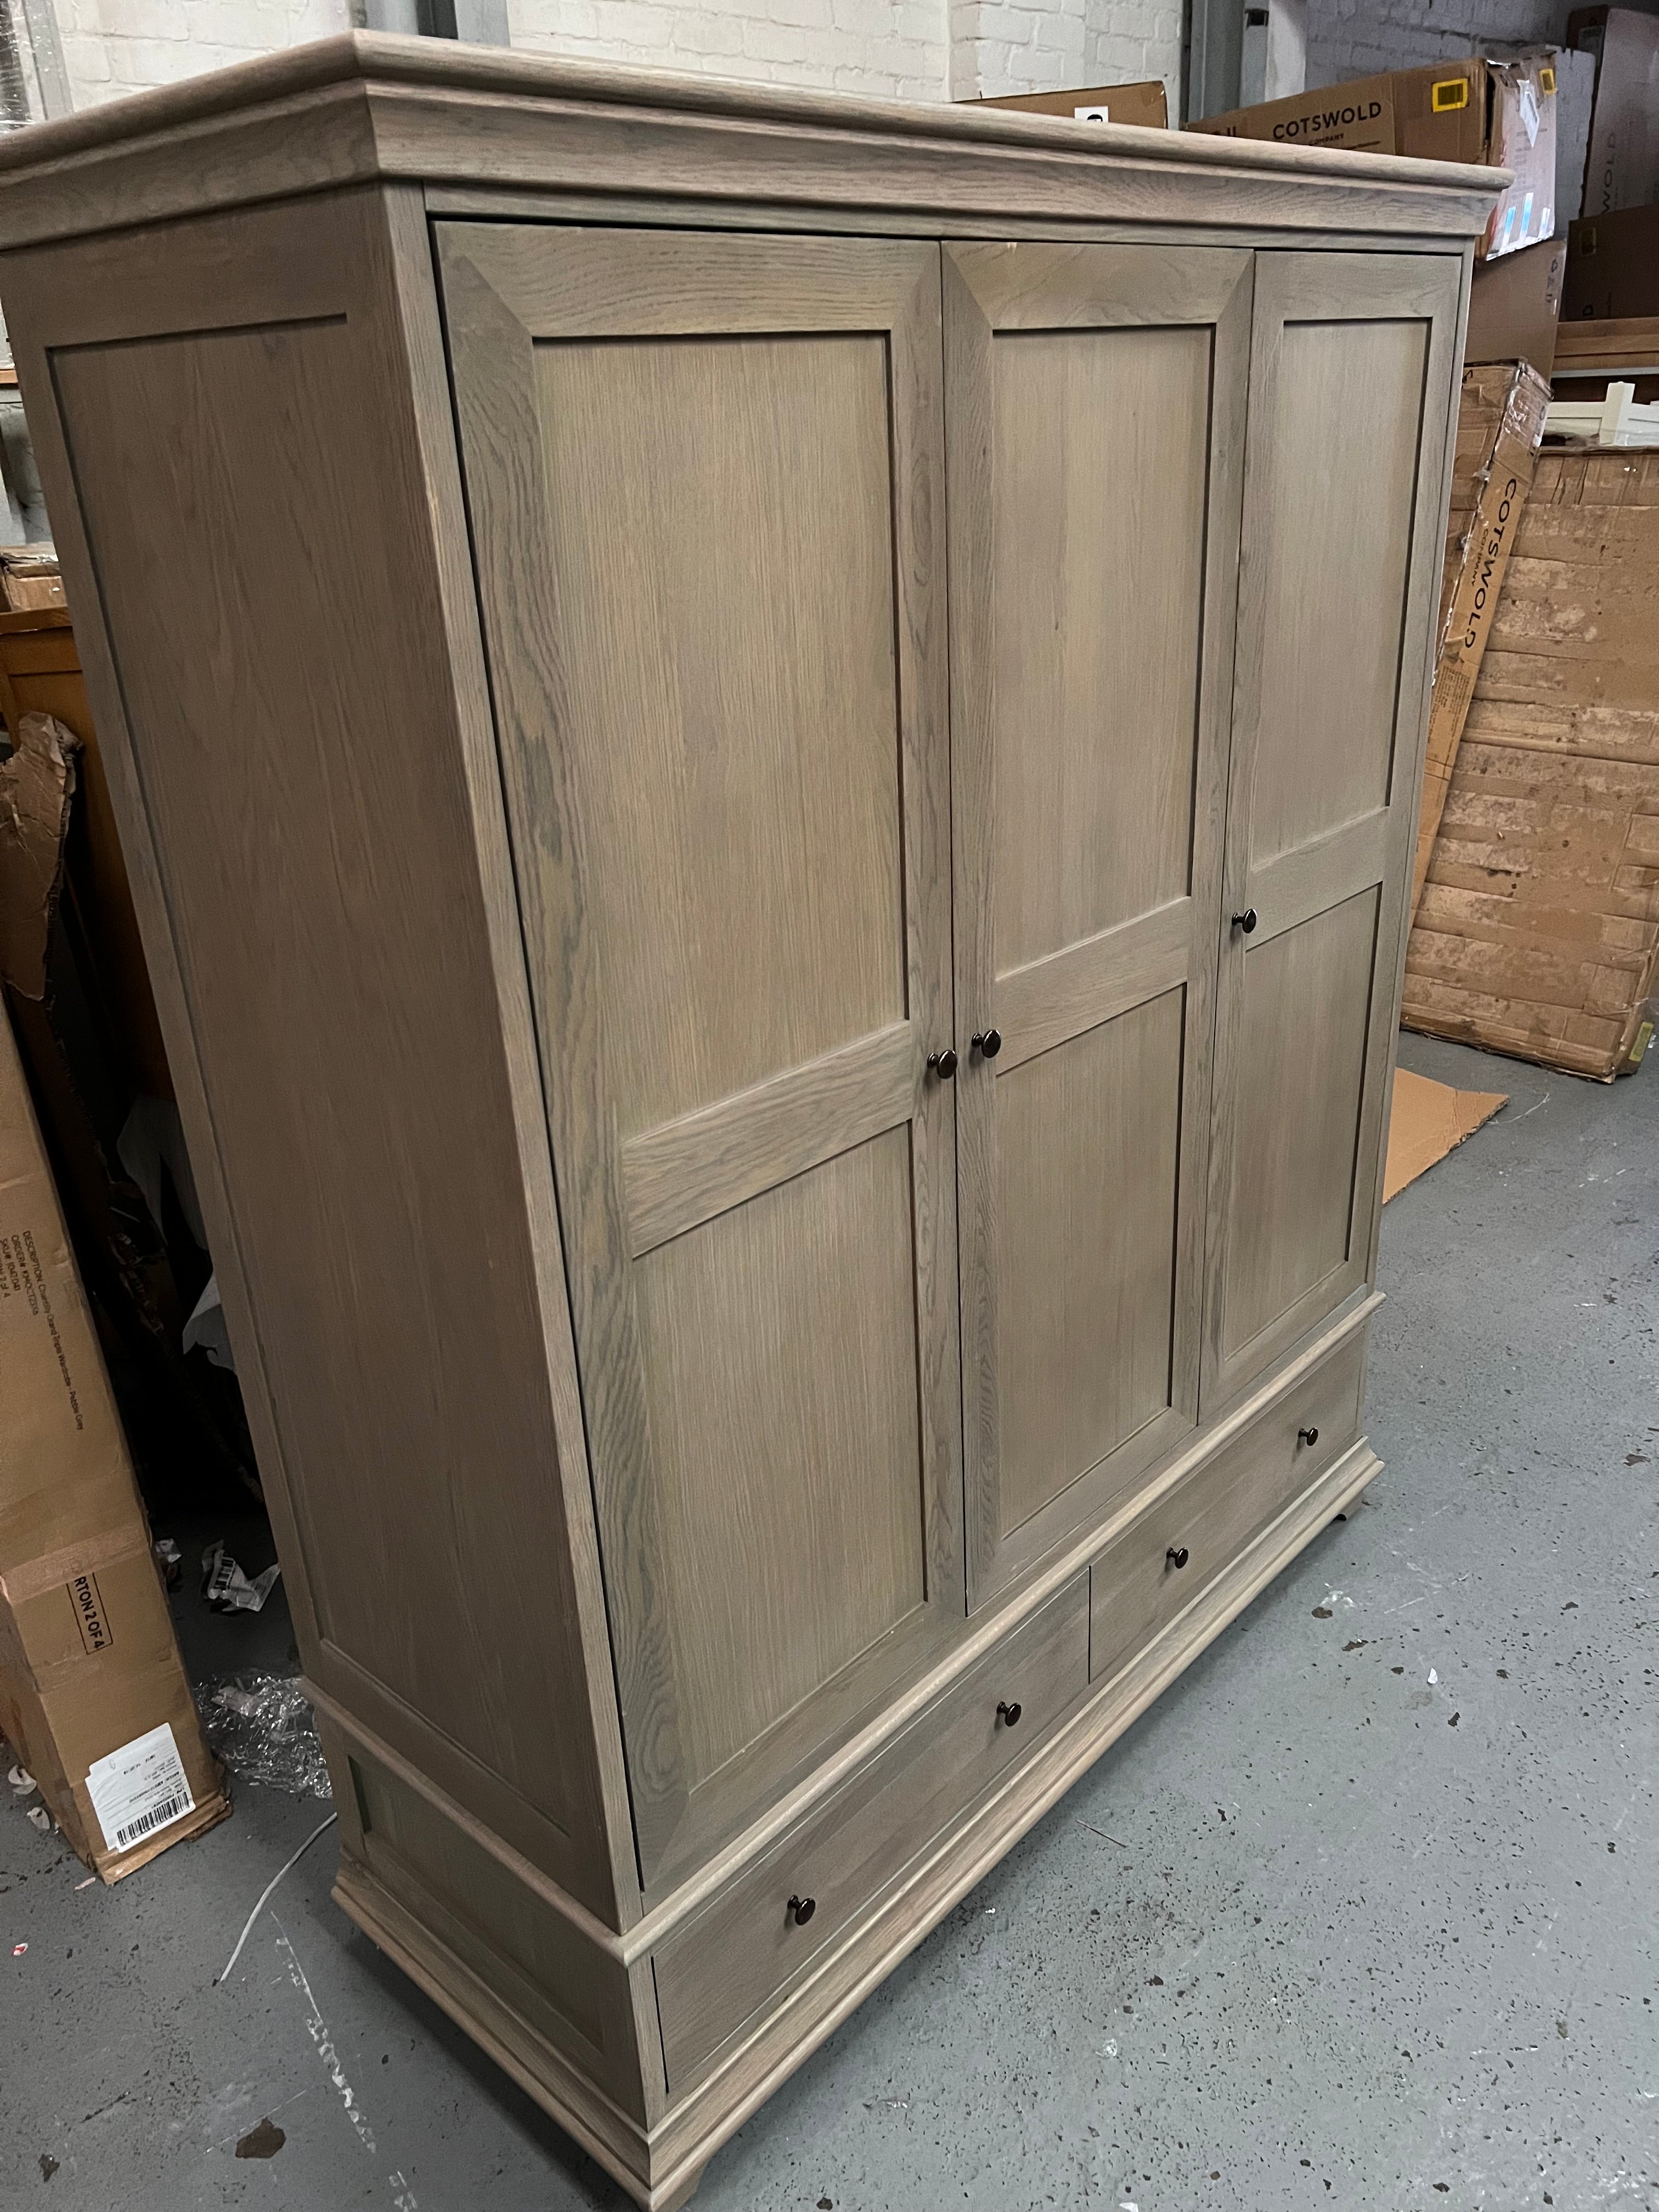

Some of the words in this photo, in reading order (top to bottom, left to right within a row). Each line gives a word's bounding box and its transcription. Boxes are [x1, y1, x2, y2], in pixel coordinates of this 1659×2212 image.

[1273, 102, 1381, 139] COTSWOLD
[1465, 478, 1517, 648] COTSWOLD
[85, 1611, 97, 1621] 2
[88, 1622, 103, 1638] OF
